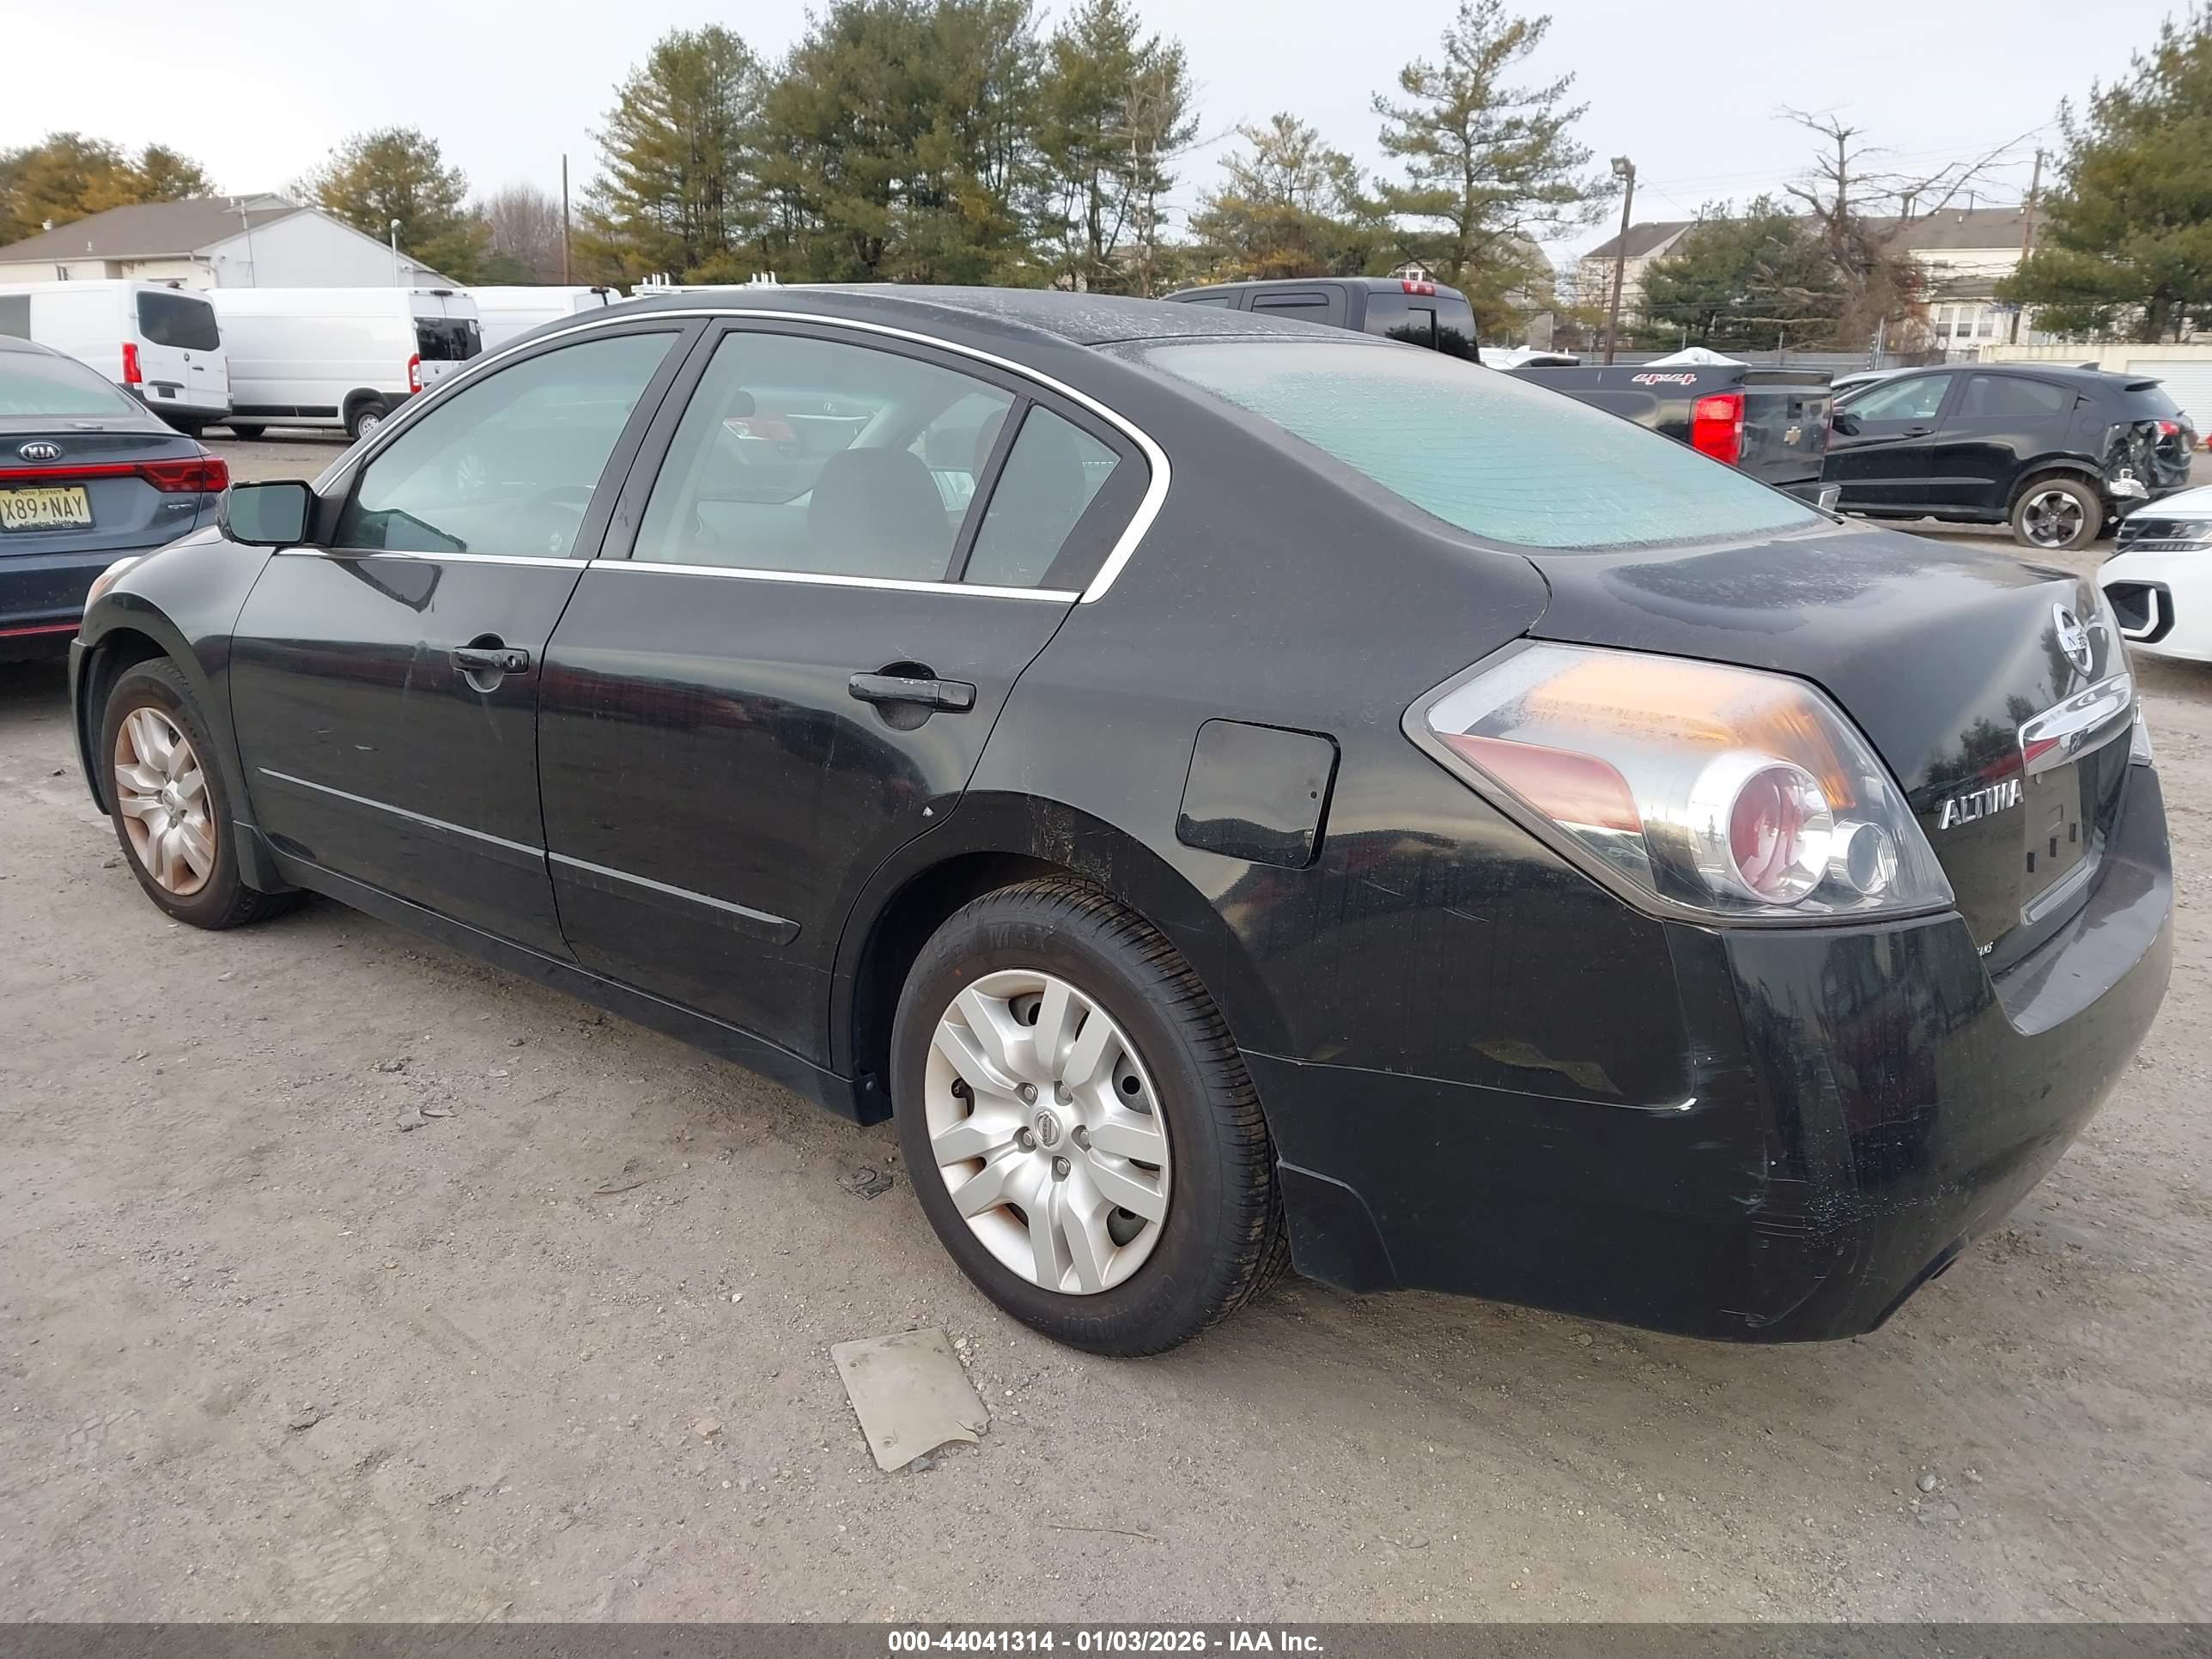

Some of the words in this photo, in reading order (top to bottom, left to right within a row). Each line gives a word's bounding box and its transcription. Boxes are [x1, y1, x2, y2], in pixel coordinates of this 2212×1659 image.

[27, 446, 56, 459] KIA
[2, 498, 37, 520] X89
[49, 495, 83, 518] NAY
[1938, 779, 2024, 830] ALTIMA
